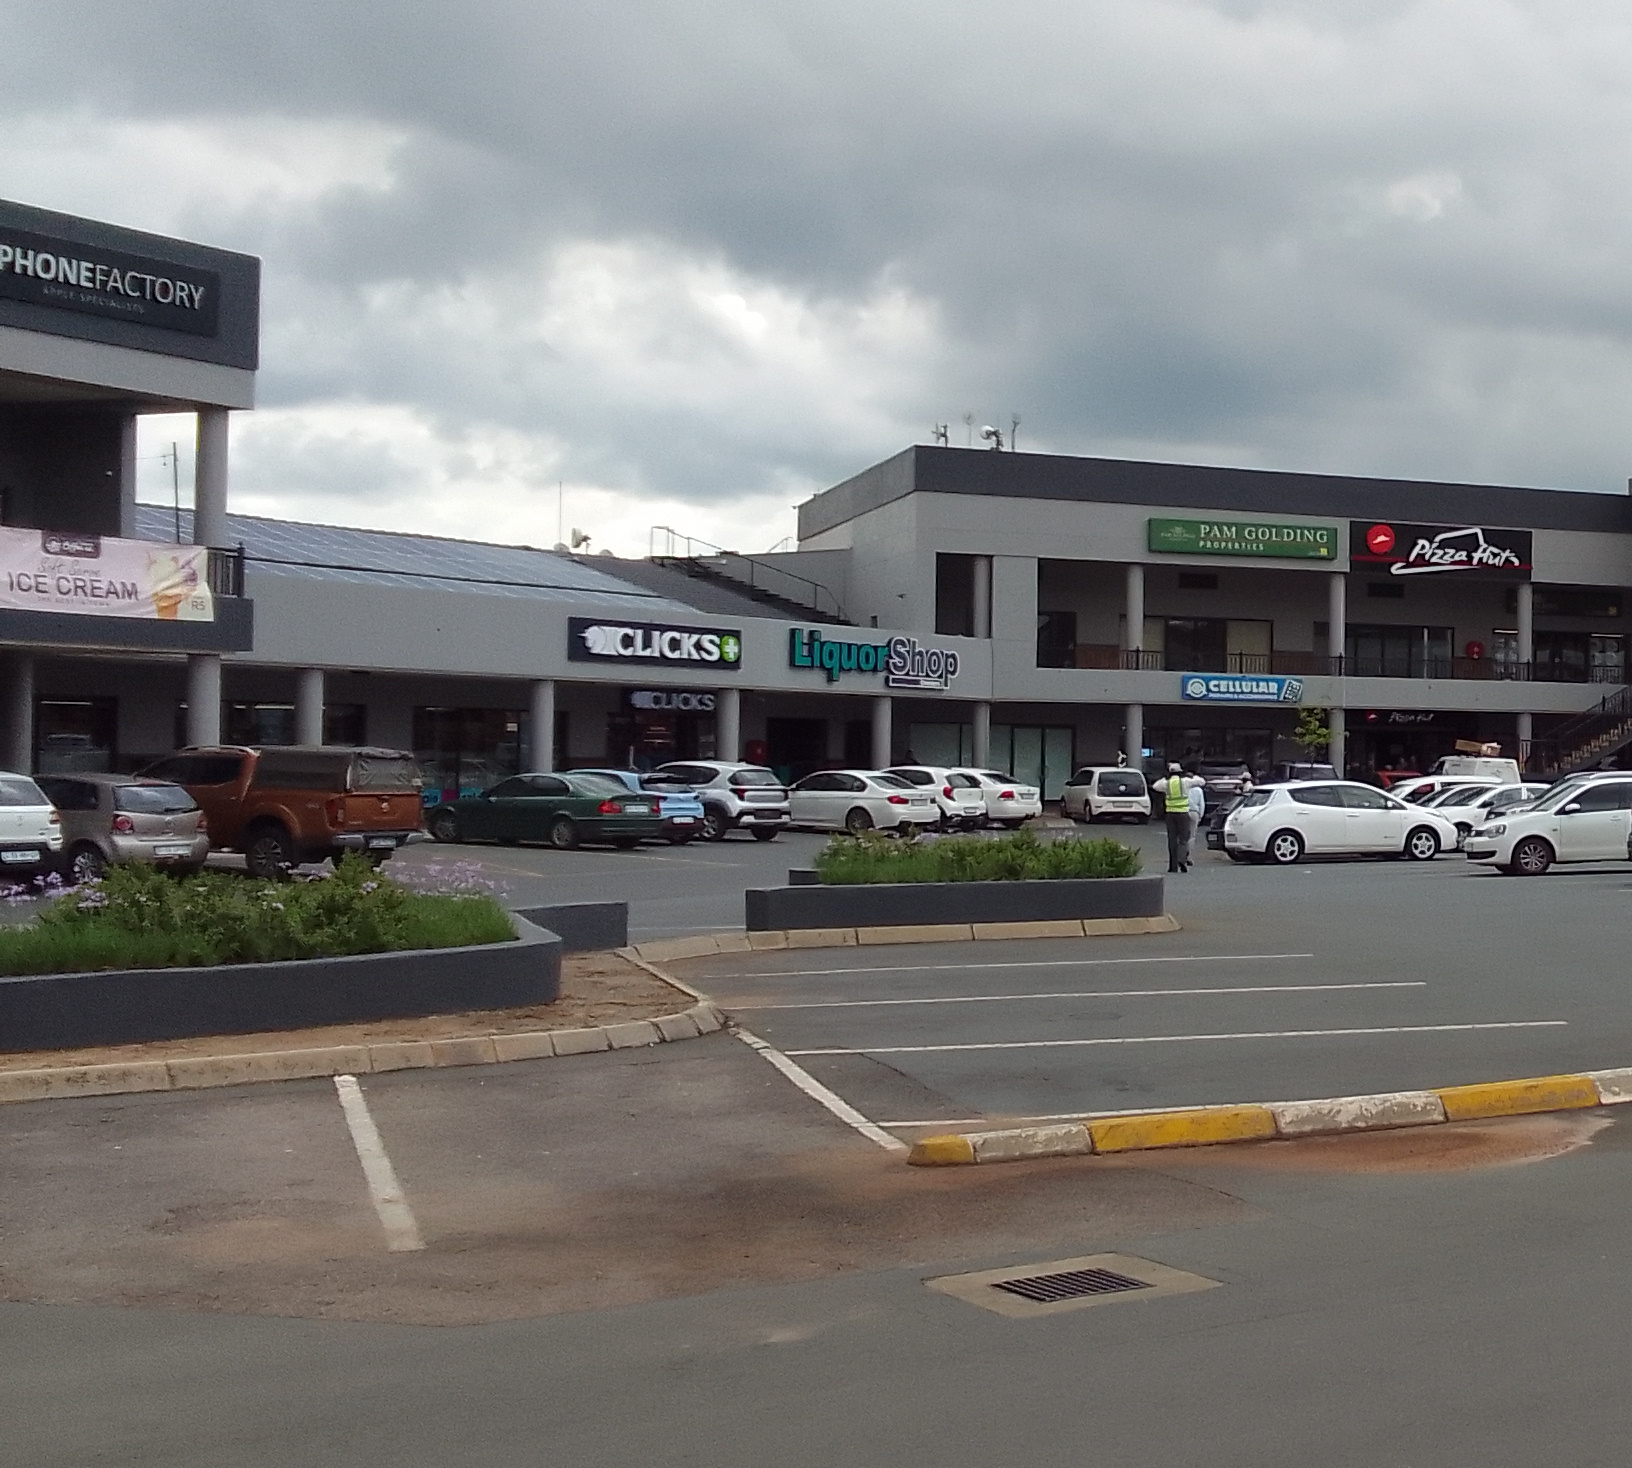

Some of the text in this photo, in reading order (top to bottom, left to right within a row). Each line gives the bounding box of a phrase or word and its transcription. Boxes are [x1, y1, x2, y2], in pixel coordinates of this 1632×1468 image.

[1200, 524, 1236, 539] PAM
[1244, 527, 1328, 543] GOLDING
[1199, 540, 1264, 551] PROPERTIES
[1408, 539, 1520, 567] Pizza Hut
[8, 571, 50, 594] ICE
[56, 576, 139, 601] CREAM
[616, 628, 721, 662] CLICKS
[1208, 680, 1278, 694] CELLULAR
[650, 692, 716, 711] CLICKS
